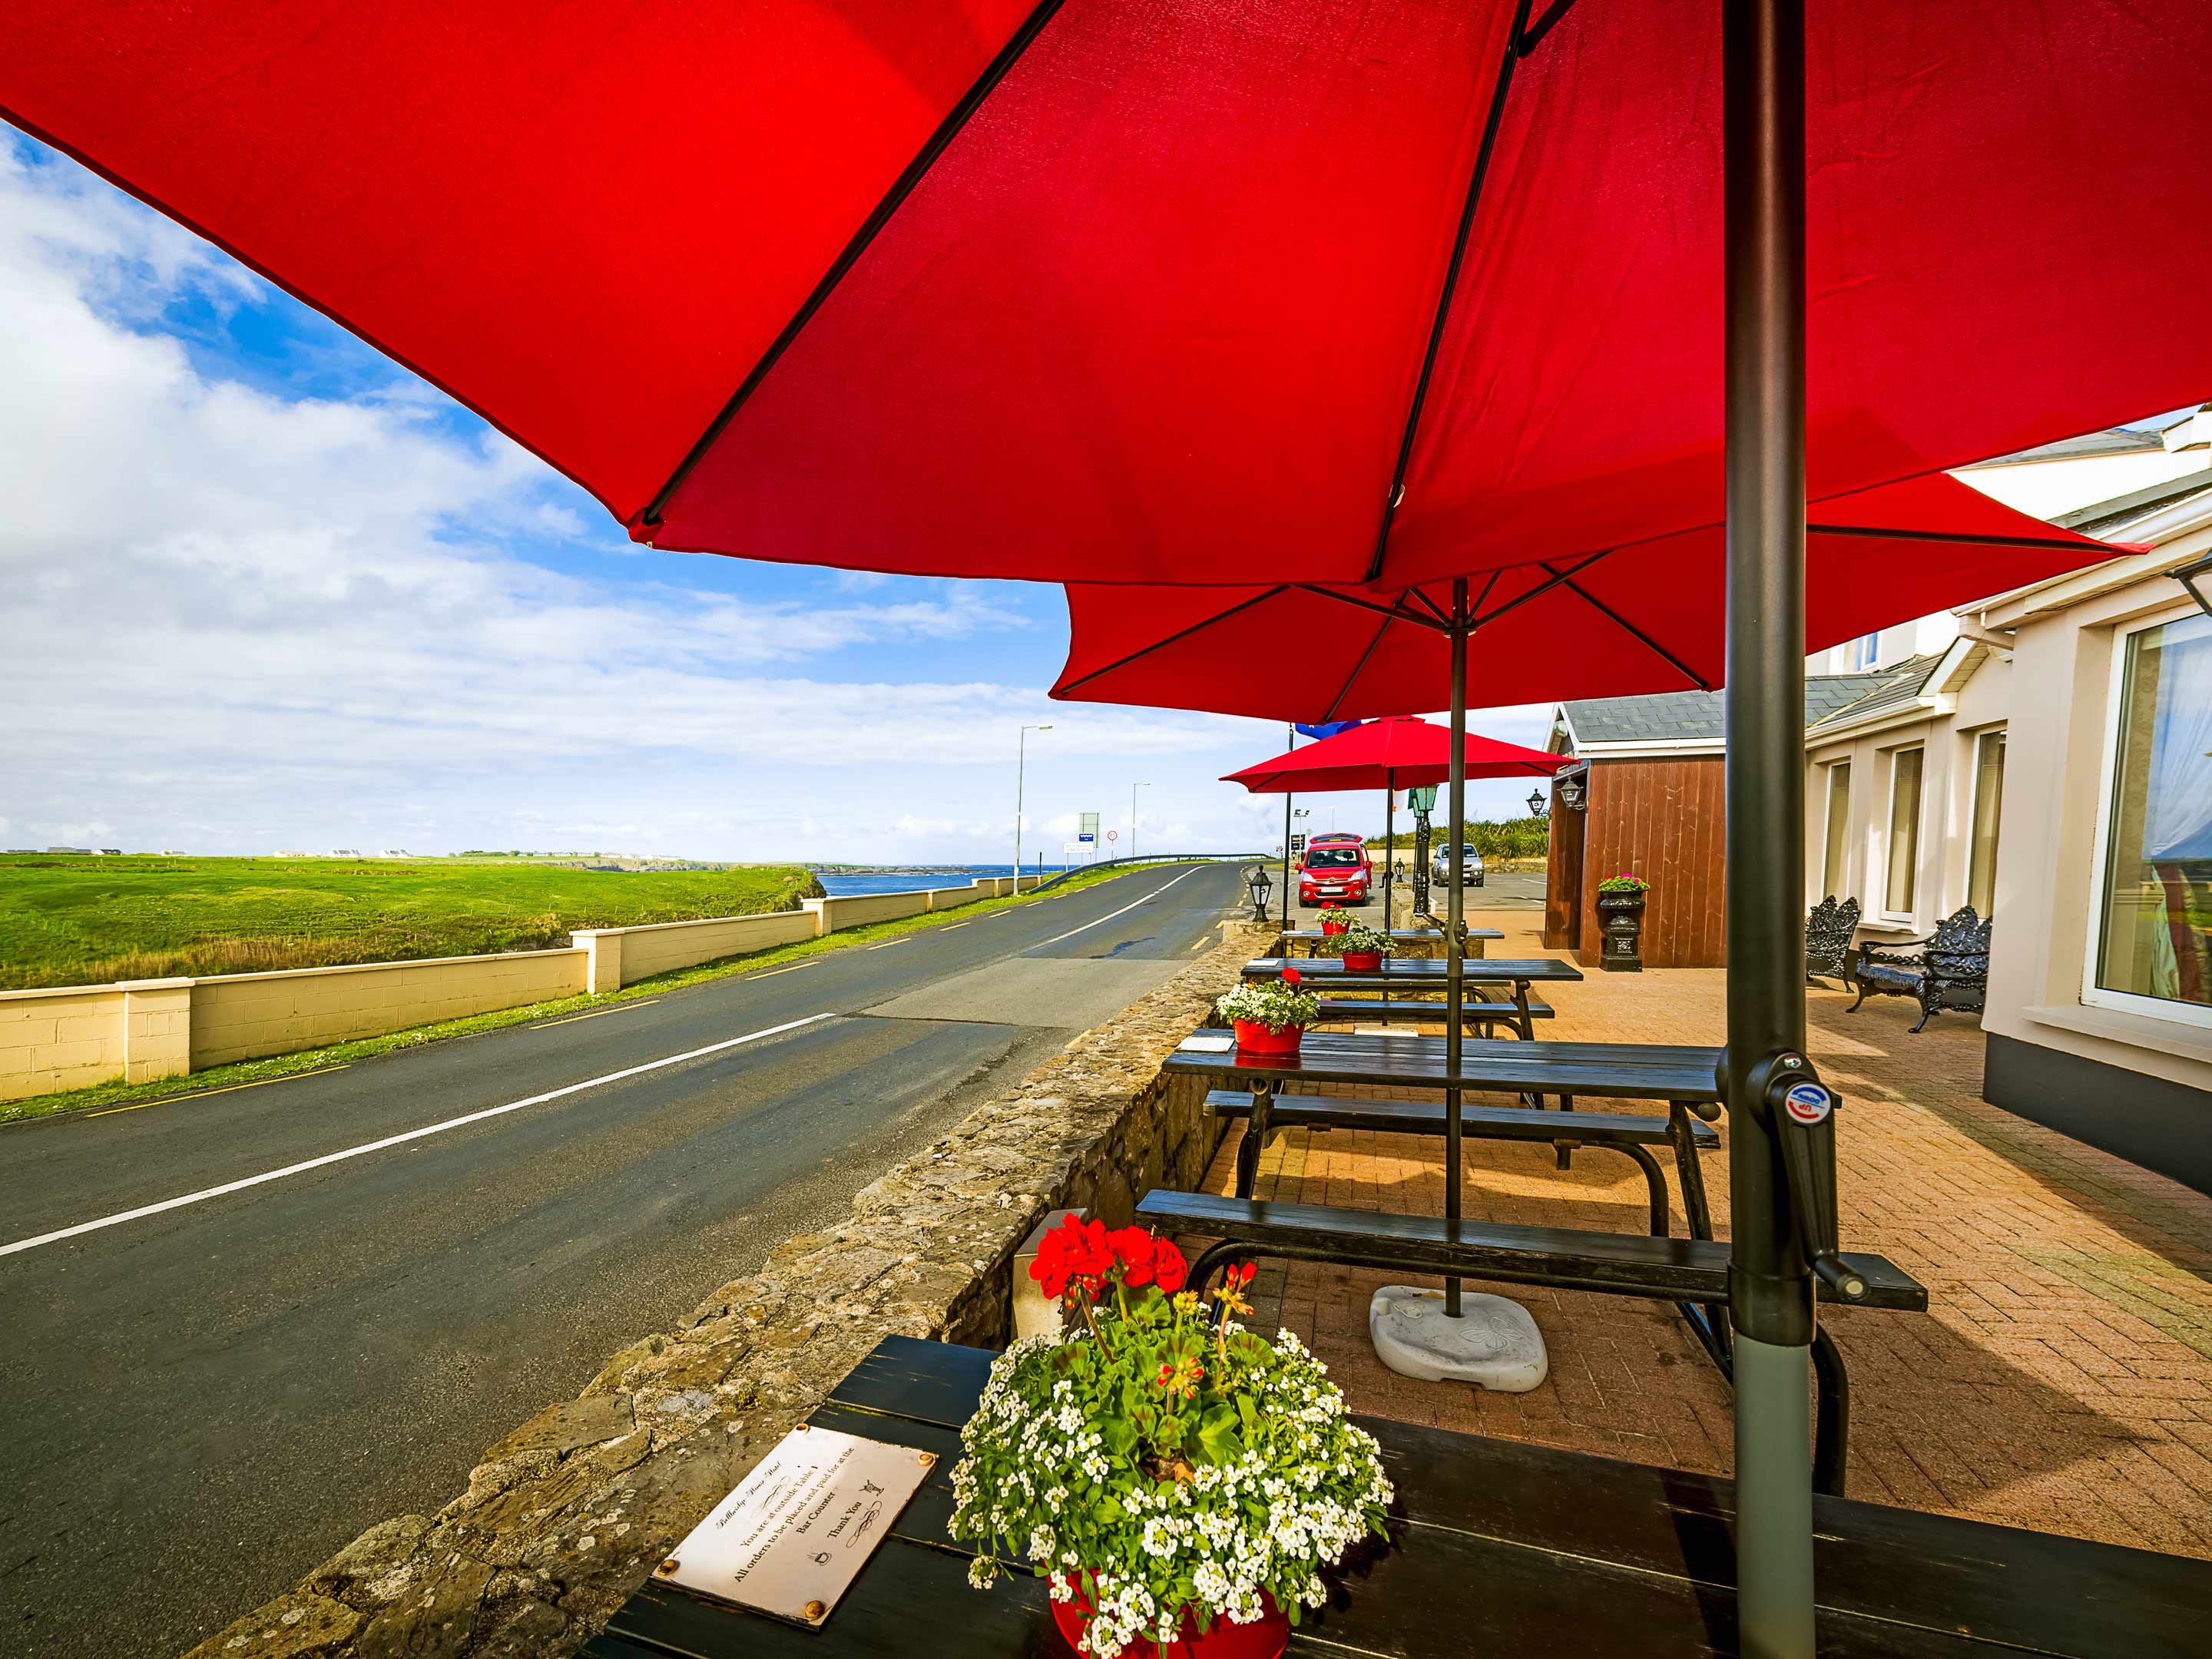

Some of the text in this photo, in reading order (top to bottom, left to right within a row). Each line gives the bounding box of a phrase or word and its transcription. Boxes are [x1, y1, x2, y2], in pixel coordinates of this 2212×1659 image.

[745, 1480, 764, 1498] House
[764, 1460, 781, 1478] Hotel
[734, 1568, 750, 1583] All
[747, 1544, 771, 1568] orders
[767, 1535, 779, 1543] to
[773, 1525, 787, 1535] be
[785, 1501, 807, 1525] placed
[805, 1488, 819, 1502] and
[816, 1473, 831, 1488] paid
[826, 1464, 839, 1473] for
[842, 1447, 855, 1458] the
[740, 1533, 758, 1547] You
[757, 1520, 769, 1533] are
[774, 1488, 799, 1512] outside
[793, 1470, 813, 1487] Table
[796, 1492, 836, 1535] Bar Counter
[826, 1502, 863, 1538] Thank You
